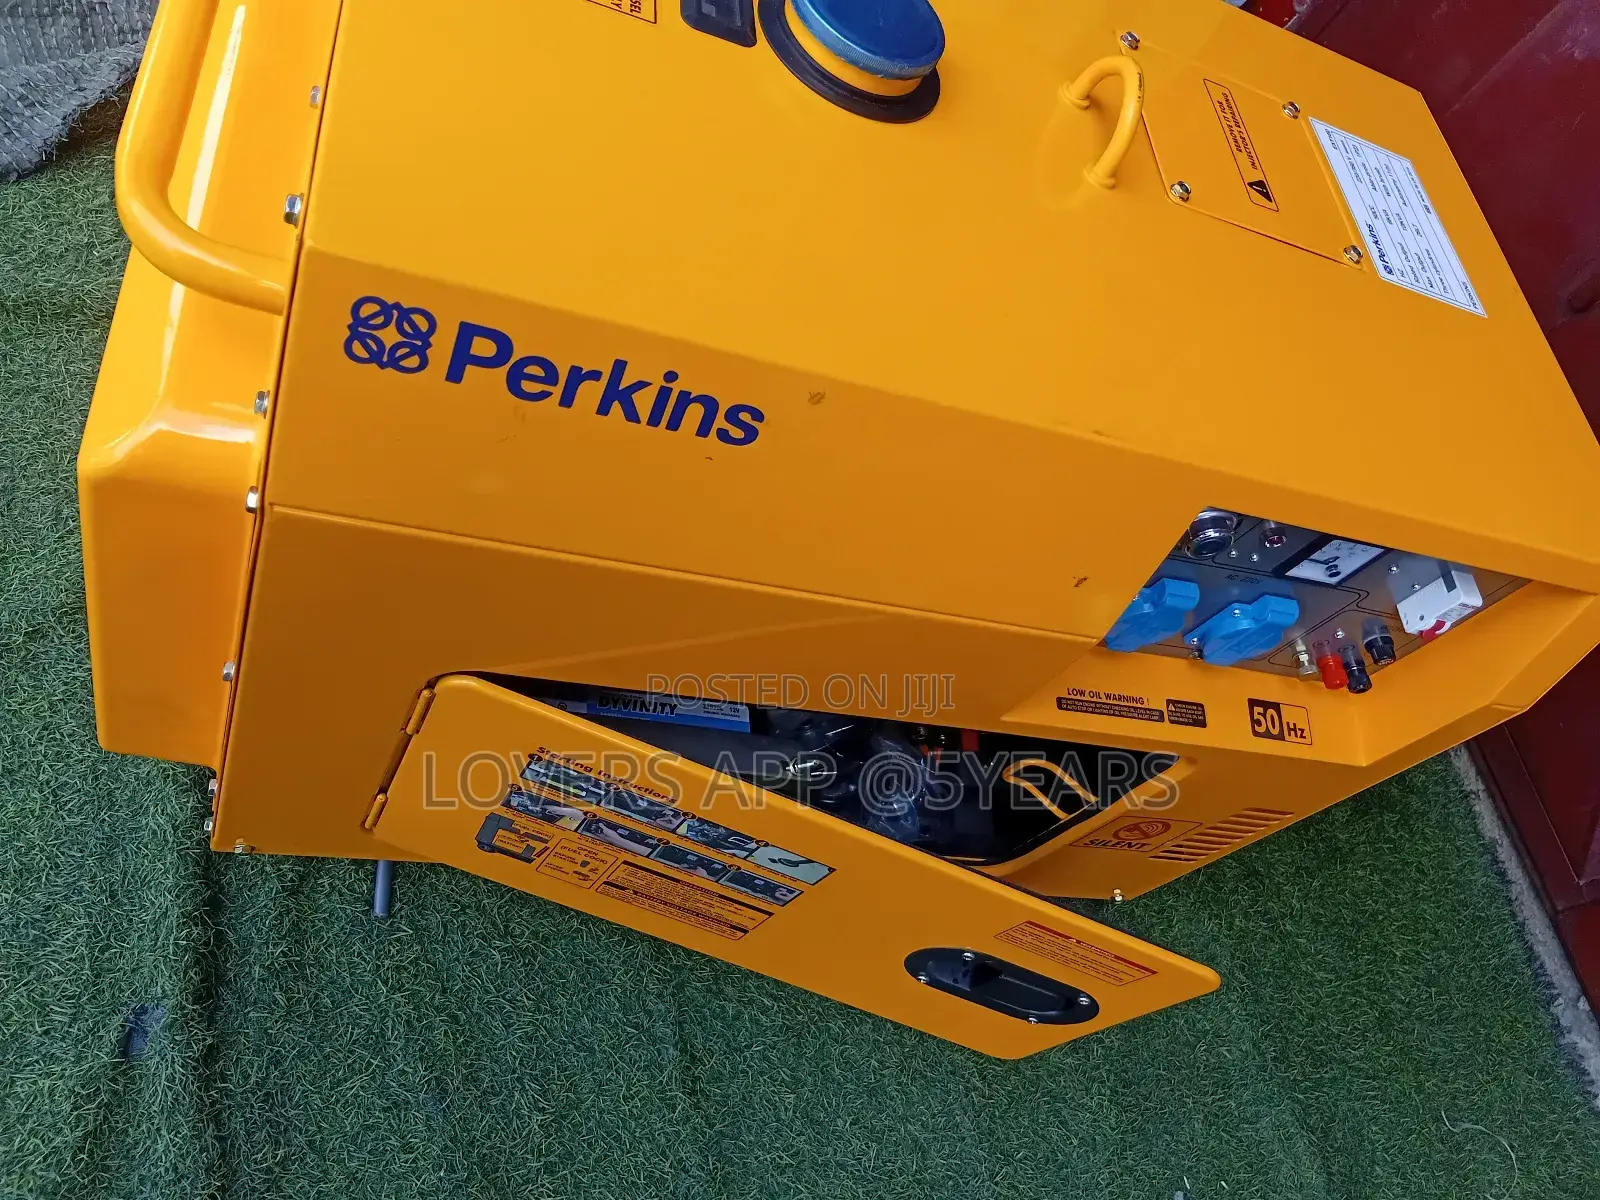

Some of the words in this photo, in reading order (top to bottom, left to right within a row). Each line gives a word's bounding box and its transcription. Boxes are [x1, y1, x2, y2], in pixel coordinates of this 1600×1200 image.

[1217, 100, 1227, 114] FOR
[1222, 92, 1242, 129] REPAIRING
[1222, 115, 1230, 124] IT
[1226, 124, 1242, 153] REMOVE
[1237, 129, 1258, 170] INJECTOR'S
[1364, 223, 1390, 264] Perkins
[1396, 241, 1411, 263] Output
[1412, 251, 1428, 273] Output
[1423, 274, 1435, 289] Max
[444, 320, 765, 447] Perkins
[1066, 688, 1086, 698] LOW
[1088, 690, 1103, 700] OIL
[1104, 692, 1145, 706] WARNING
[1254, 706, 1280, 736] 50
[1286, 722, 1307, 740] Hz
[535, 746, 594, 772] Starting
[596, 769, 678, 803] Instructions
[559, 845, 583, 855] (FUEL
[582, 853, 608, 864] COCK)
[576, 846, 598, 856] OPEN
[1083, 838, 1152, 850] SILENT
